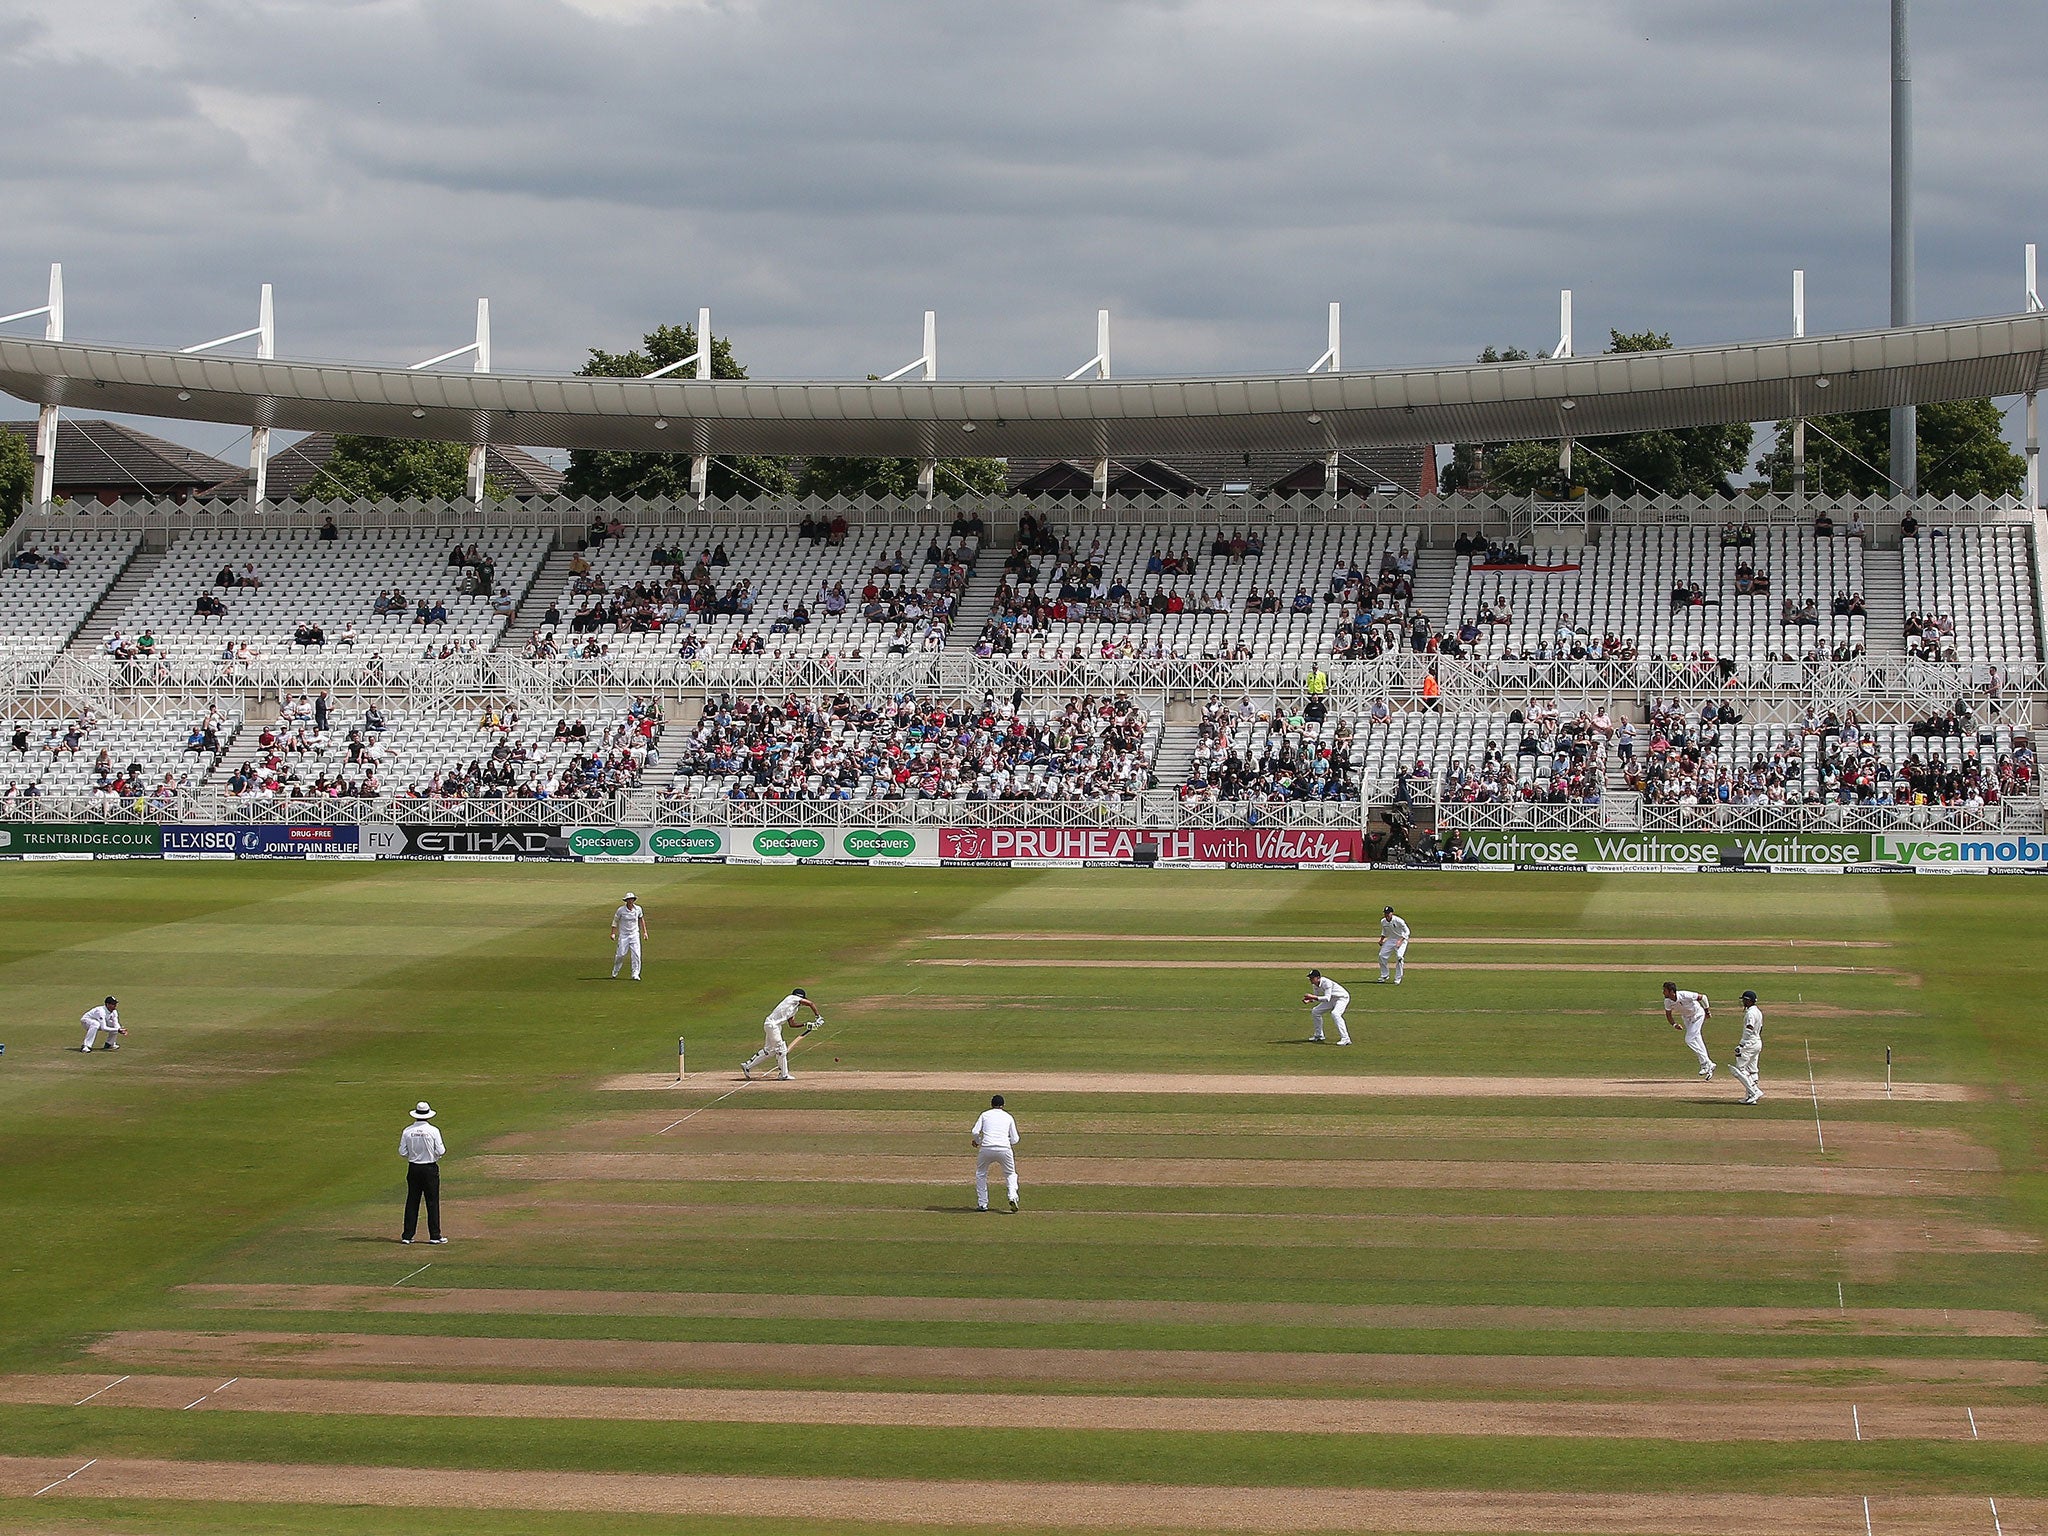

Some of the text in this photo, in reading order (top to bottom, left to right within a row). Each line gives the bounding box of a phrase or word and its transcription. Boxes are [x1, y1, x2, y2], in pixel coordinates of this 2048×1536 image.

[24, 833, 152, 846] TRENTBRIDGE.CO.UK
[163, 833, 236, 850] FLEXISEQ
[369, 833, 395, 847] FLY
[575, 836, 634, 849] Specsavers
[656, 836, 715, 849] Specsavers
[759, 837, 819, 850] Specsavers
[850, 837, 909, 850] Specsavers
[264, 843, 358, 853] JOINT PAIN RELIEF
[1202, 837, 1248, 858] with
[1256, 830, 1350, 863] Vitality
[1464, 834, 1578, 861] Waitrose
[1594, 835, 1719, 862] Waitrose
[1735, 835, 1860, 863] Waitrose
